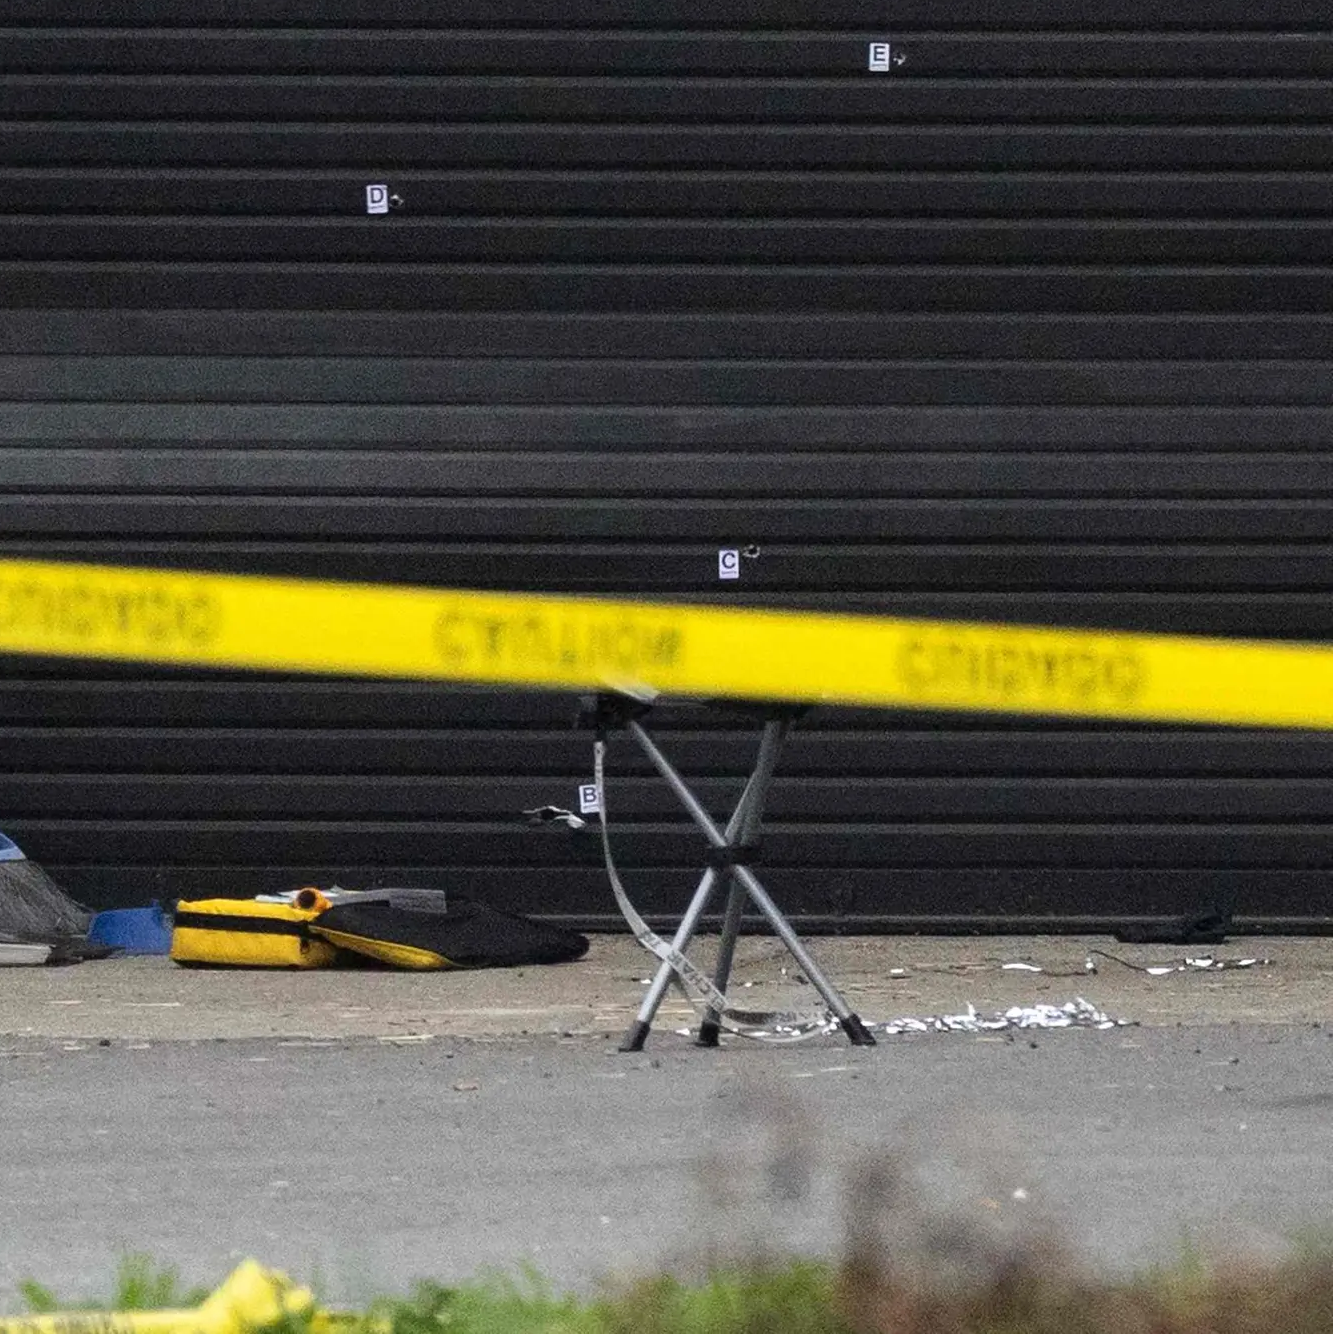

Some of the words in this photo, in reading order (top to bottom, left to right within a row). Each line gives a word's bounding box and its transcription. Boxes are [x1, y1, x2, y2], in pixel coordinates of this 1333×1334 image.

[873, 45, 886, 62] E
[370, 187, 384, 203] D
[721, 552, 736, 569] C
[582, 786, 597, 804] B
